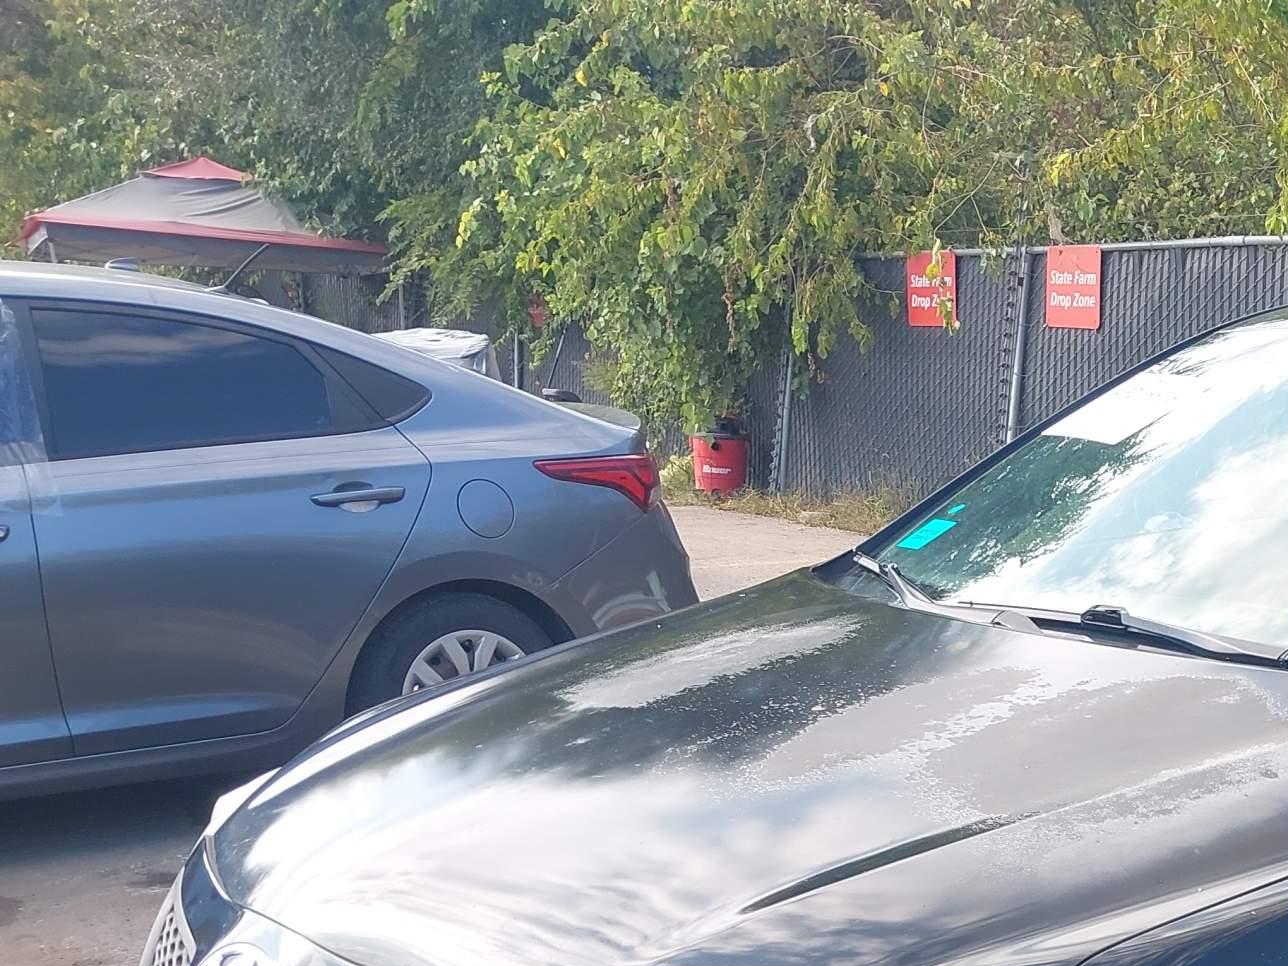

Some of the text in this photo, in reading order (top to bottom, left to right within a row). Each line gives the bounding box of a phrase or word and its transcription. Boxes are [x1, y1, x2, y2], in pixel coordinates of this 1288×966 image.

[1050, 270, 1096, 285] State Farm
[911, 295, 931, 310] Drop
[1050, 292, 1096, 310] Drop Zone
